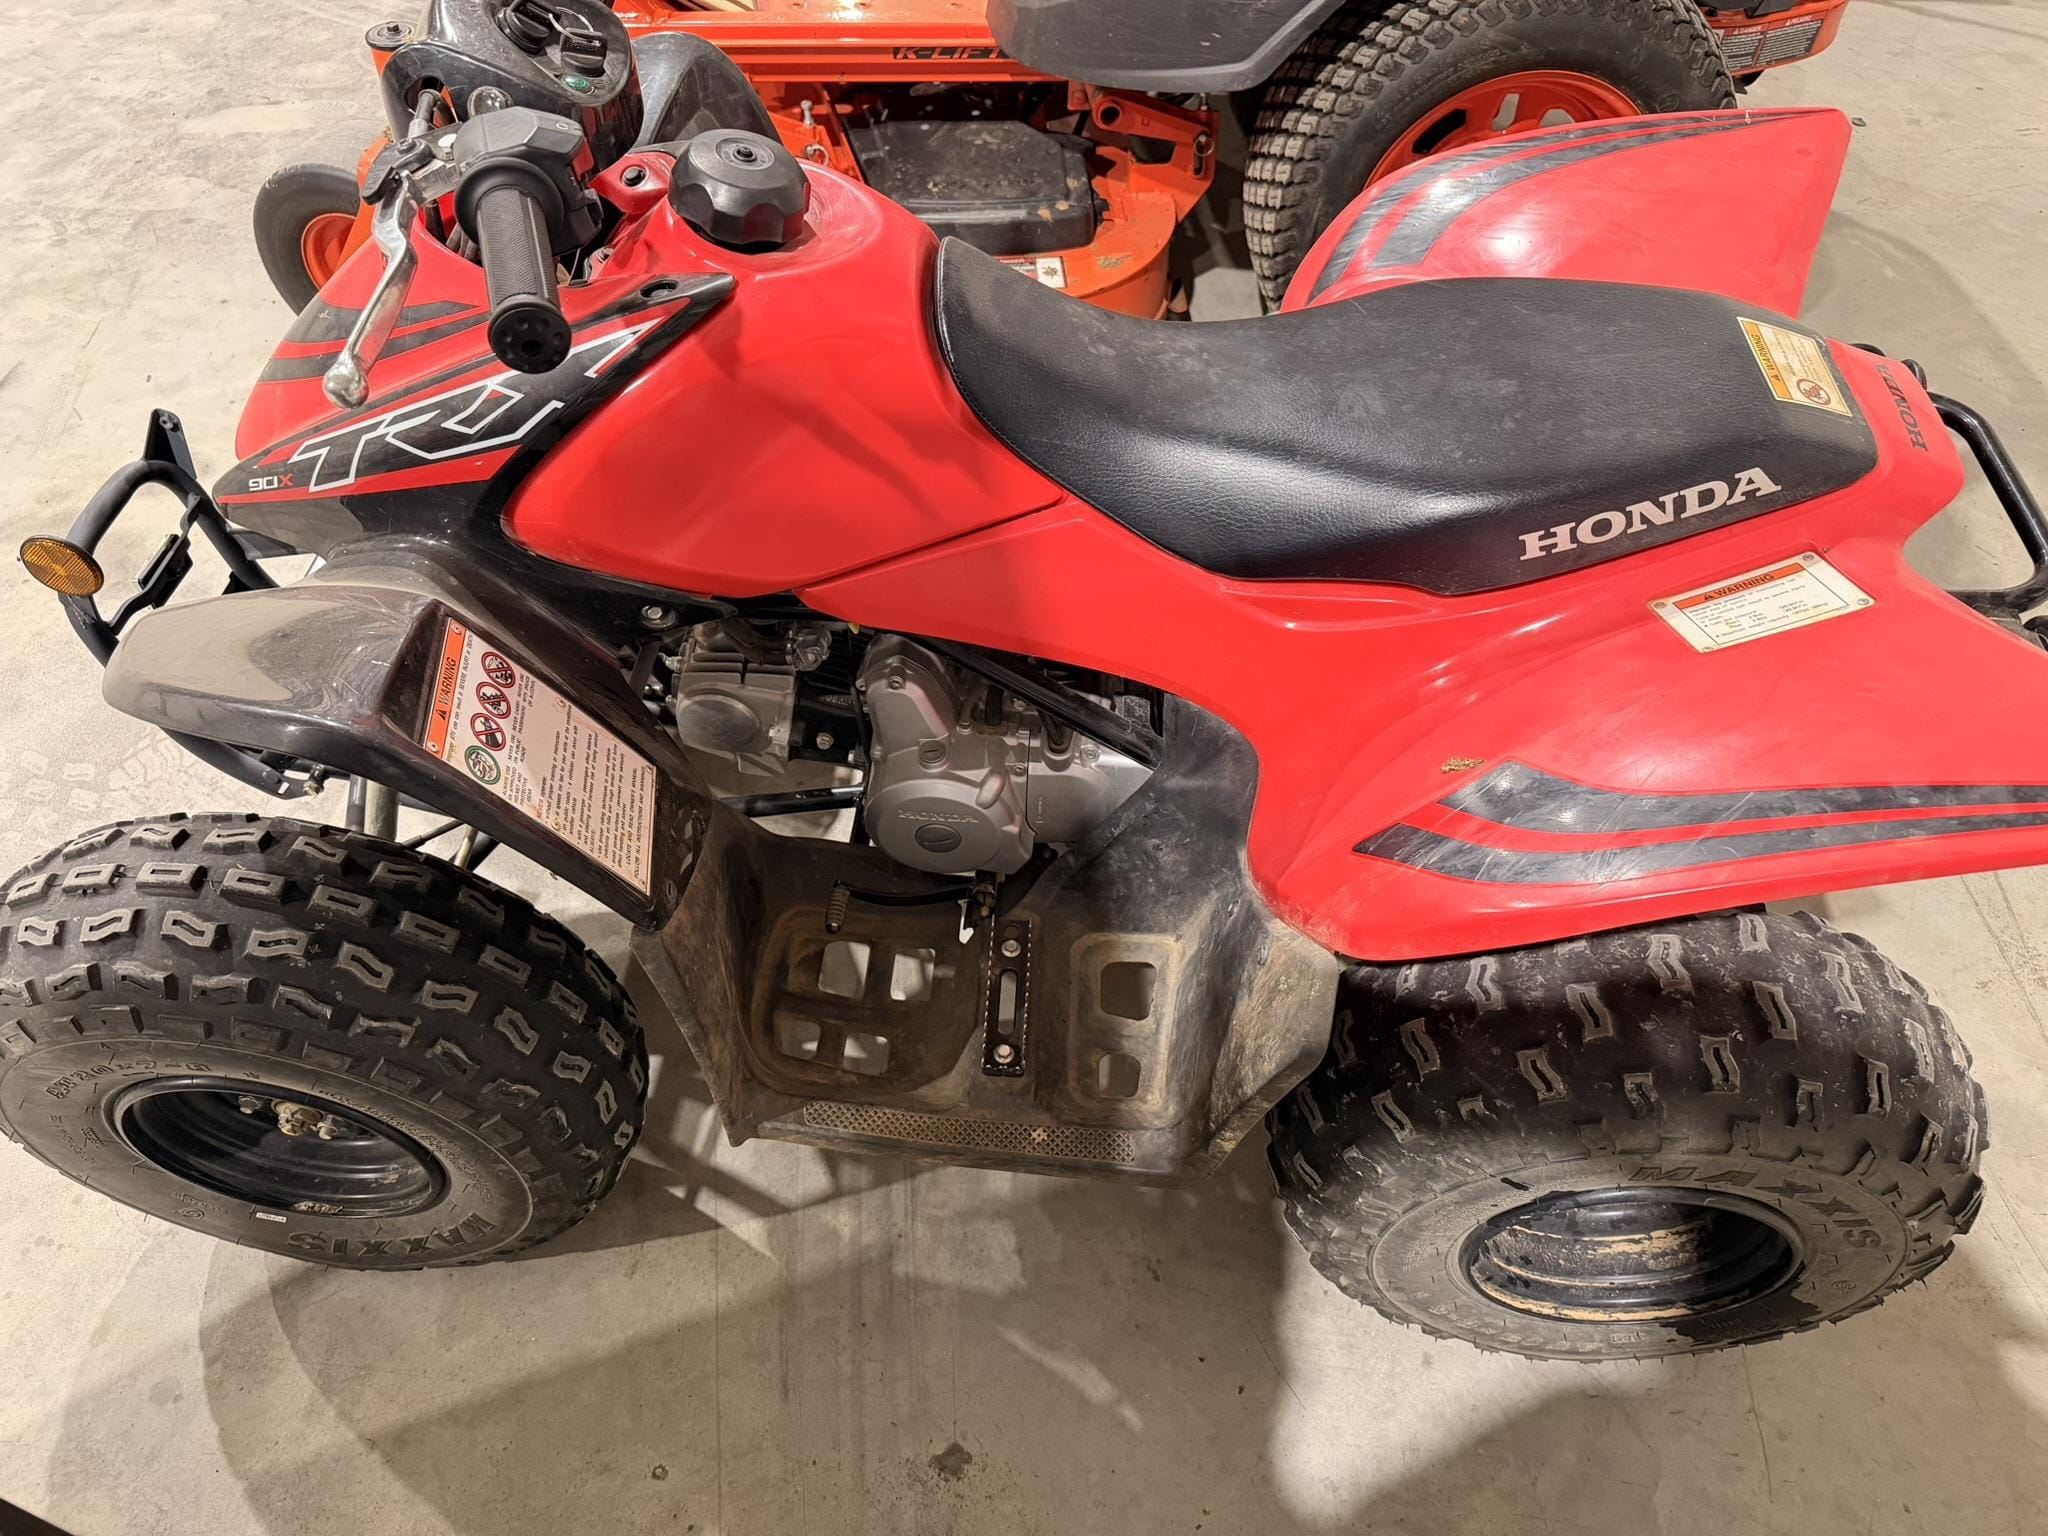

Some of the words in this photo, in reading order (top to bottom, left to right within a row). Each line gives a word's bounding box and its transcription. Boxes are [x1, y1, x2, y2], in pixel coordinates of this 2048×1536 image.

[897, 47, 1001, 59] K-LIFT
[1750, 333, 1776, 371] WARNING
[1876, 364, 1928, 452] HONDA
[249, 474, 294, 491] 90X
[1518, 466, 1782, 561] HONDA
[1713, 573, 1775, 596] WARNING
[439, 655, 455, 707] WARNING
[897, 809, 979, 823] HONDA
[1628, 1165, 1883, 1249] MAXXIS
[288, 1212, 497, 1257] MAXXIS
